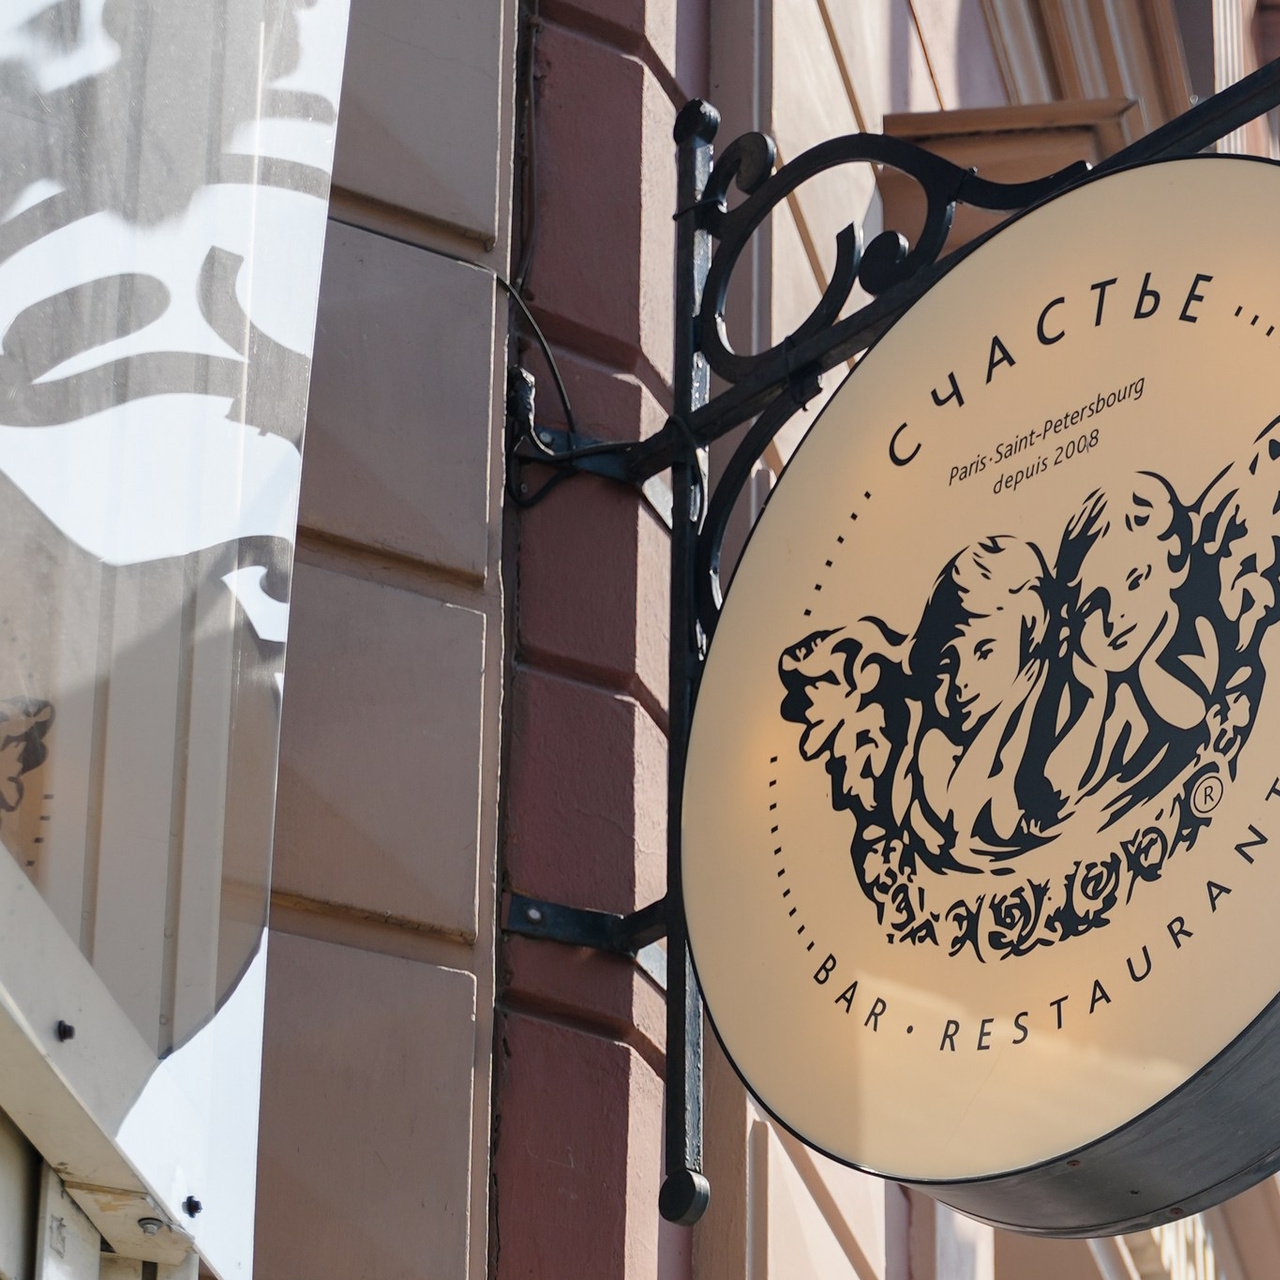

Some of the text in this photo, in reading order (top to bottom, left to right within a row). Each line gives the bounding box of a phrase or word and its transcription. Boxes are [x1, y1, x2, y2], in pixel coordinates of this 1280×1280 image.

[888, 272, 1214, 467] СЧАСТЬЕ
[992, 428, 1100, 495] depuis 2008
